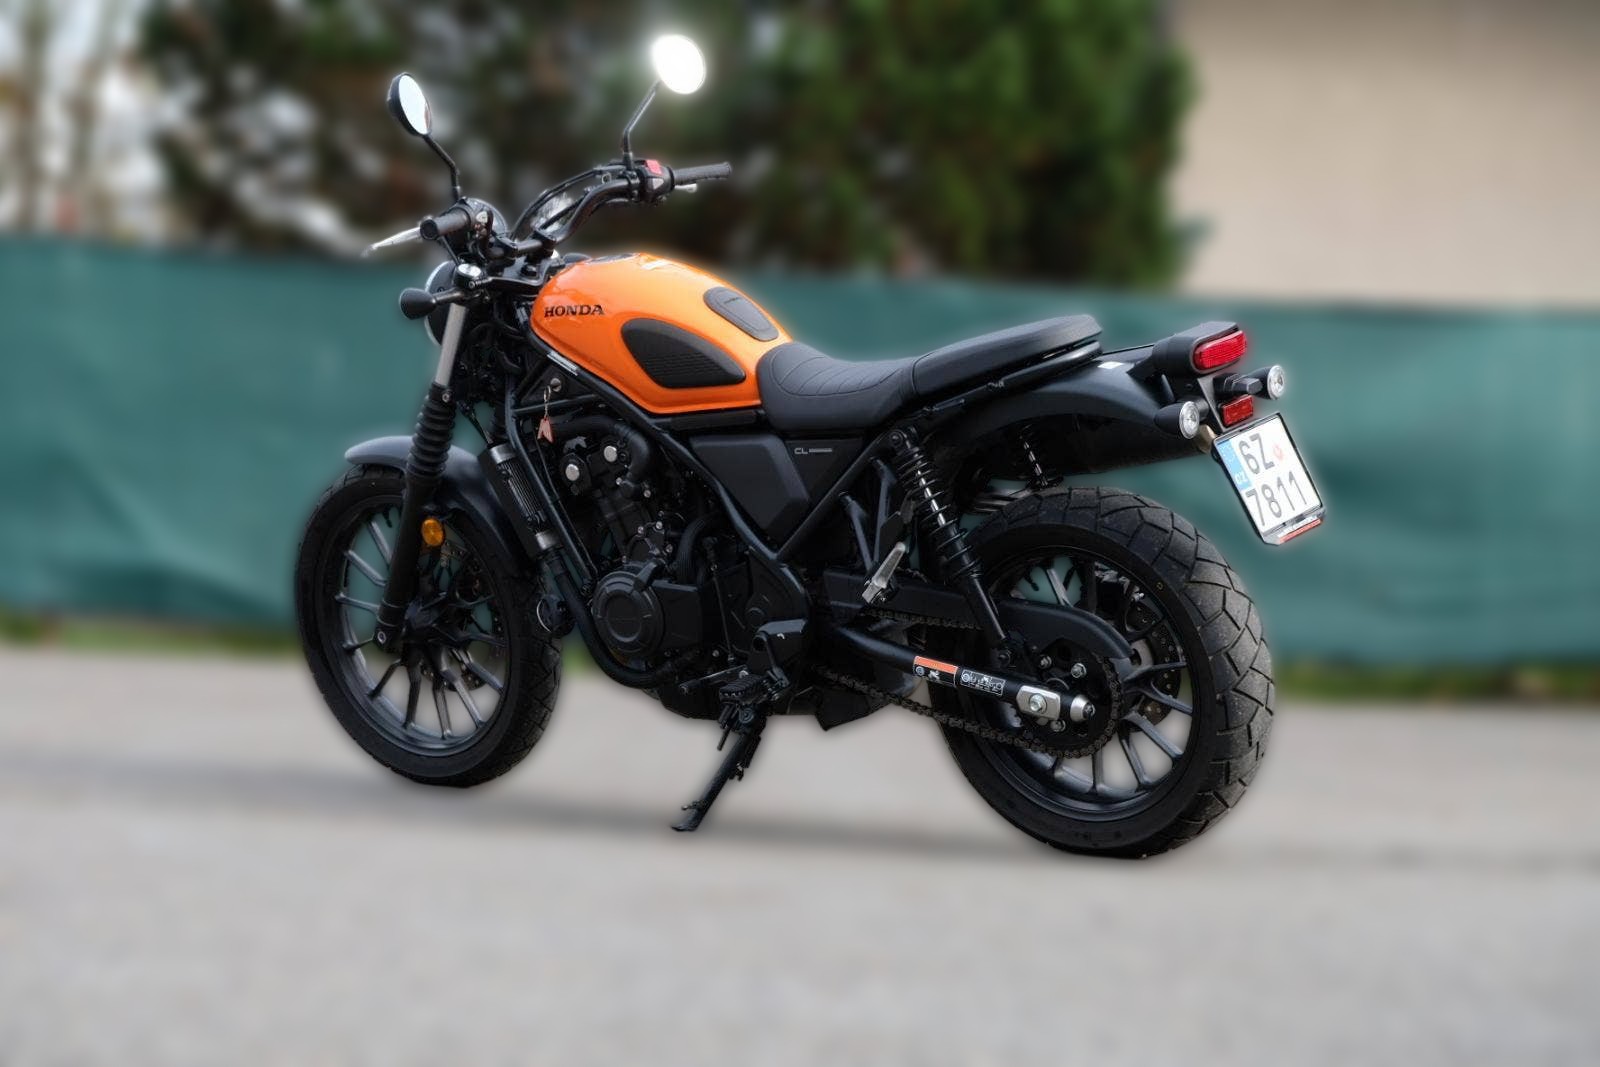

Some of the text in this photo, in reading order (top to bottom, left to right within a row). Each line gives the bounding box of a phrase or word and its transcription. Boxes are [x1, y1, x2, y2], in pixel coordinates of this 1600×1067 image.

[544, 304, 605, 318] HONDA
[794, 447, 809, 455] CL
[1238, 432, 1275, 475] 6Z
[1245, 470, 1307, 526] 7811
